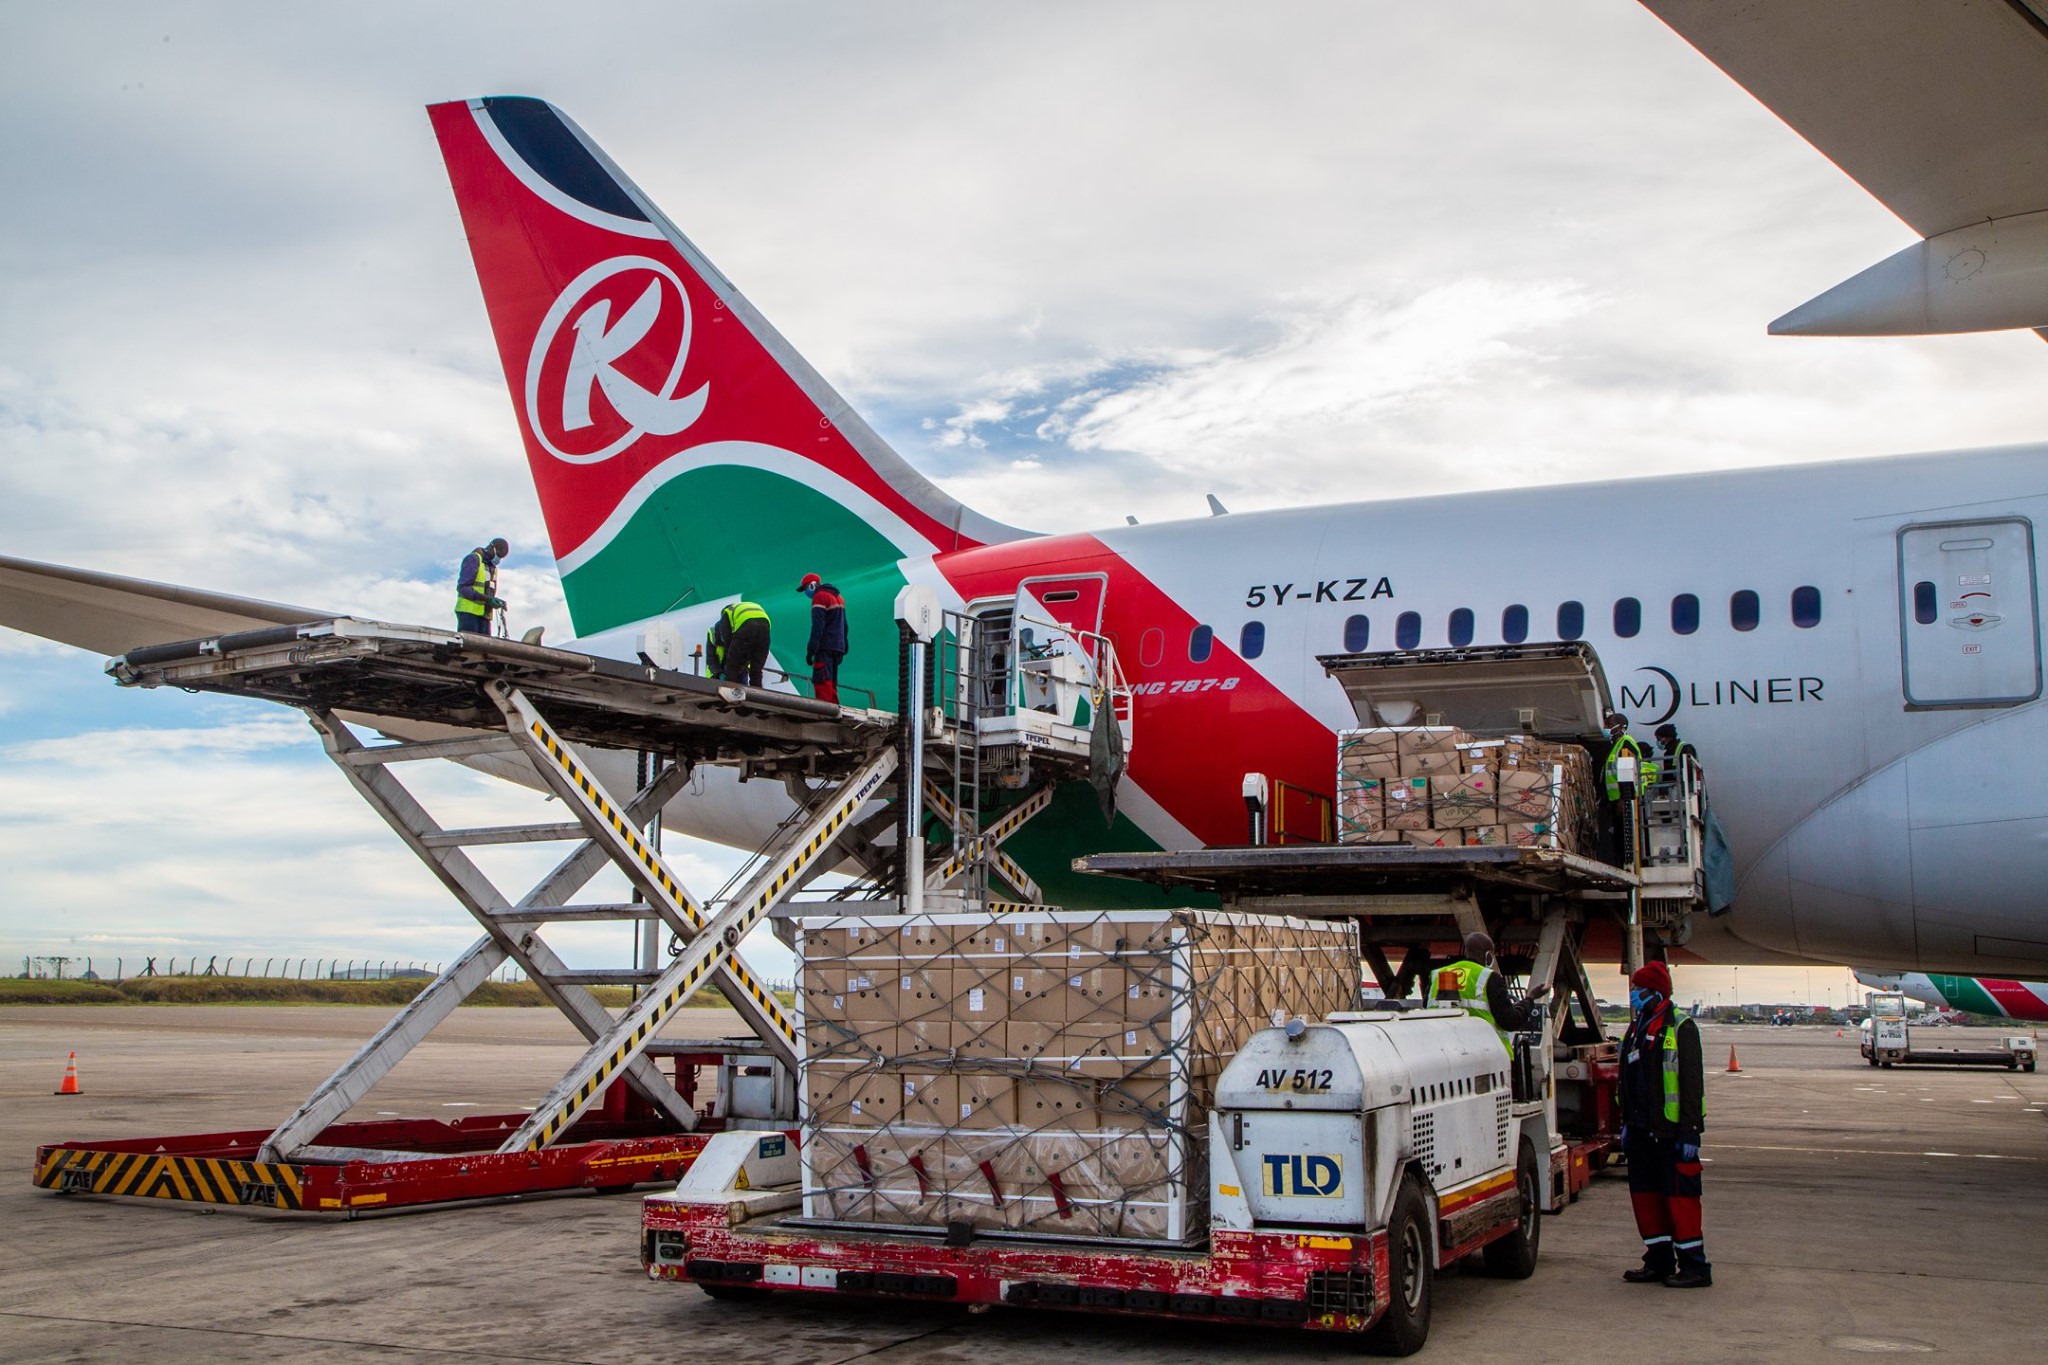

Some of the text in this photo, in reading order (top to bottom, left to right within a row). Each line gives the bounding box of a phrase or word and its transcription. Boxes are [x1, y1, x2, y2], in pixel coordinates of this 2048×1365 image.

[1246, 576, 1394, 608] 5Y-KZA
[1169, 677, 1240, 694] 787-8
[1691, 677, 1824, 706] LINER
[1025, 733, 1051, 745] TREPEL
[855, 772, 882, 801] TREPEL
[1521, 804, 1544, 815] FOOD
[1256, 1069, 1333, 1090] AV 512
[1264, 1155, 1341, 1196] TLD
